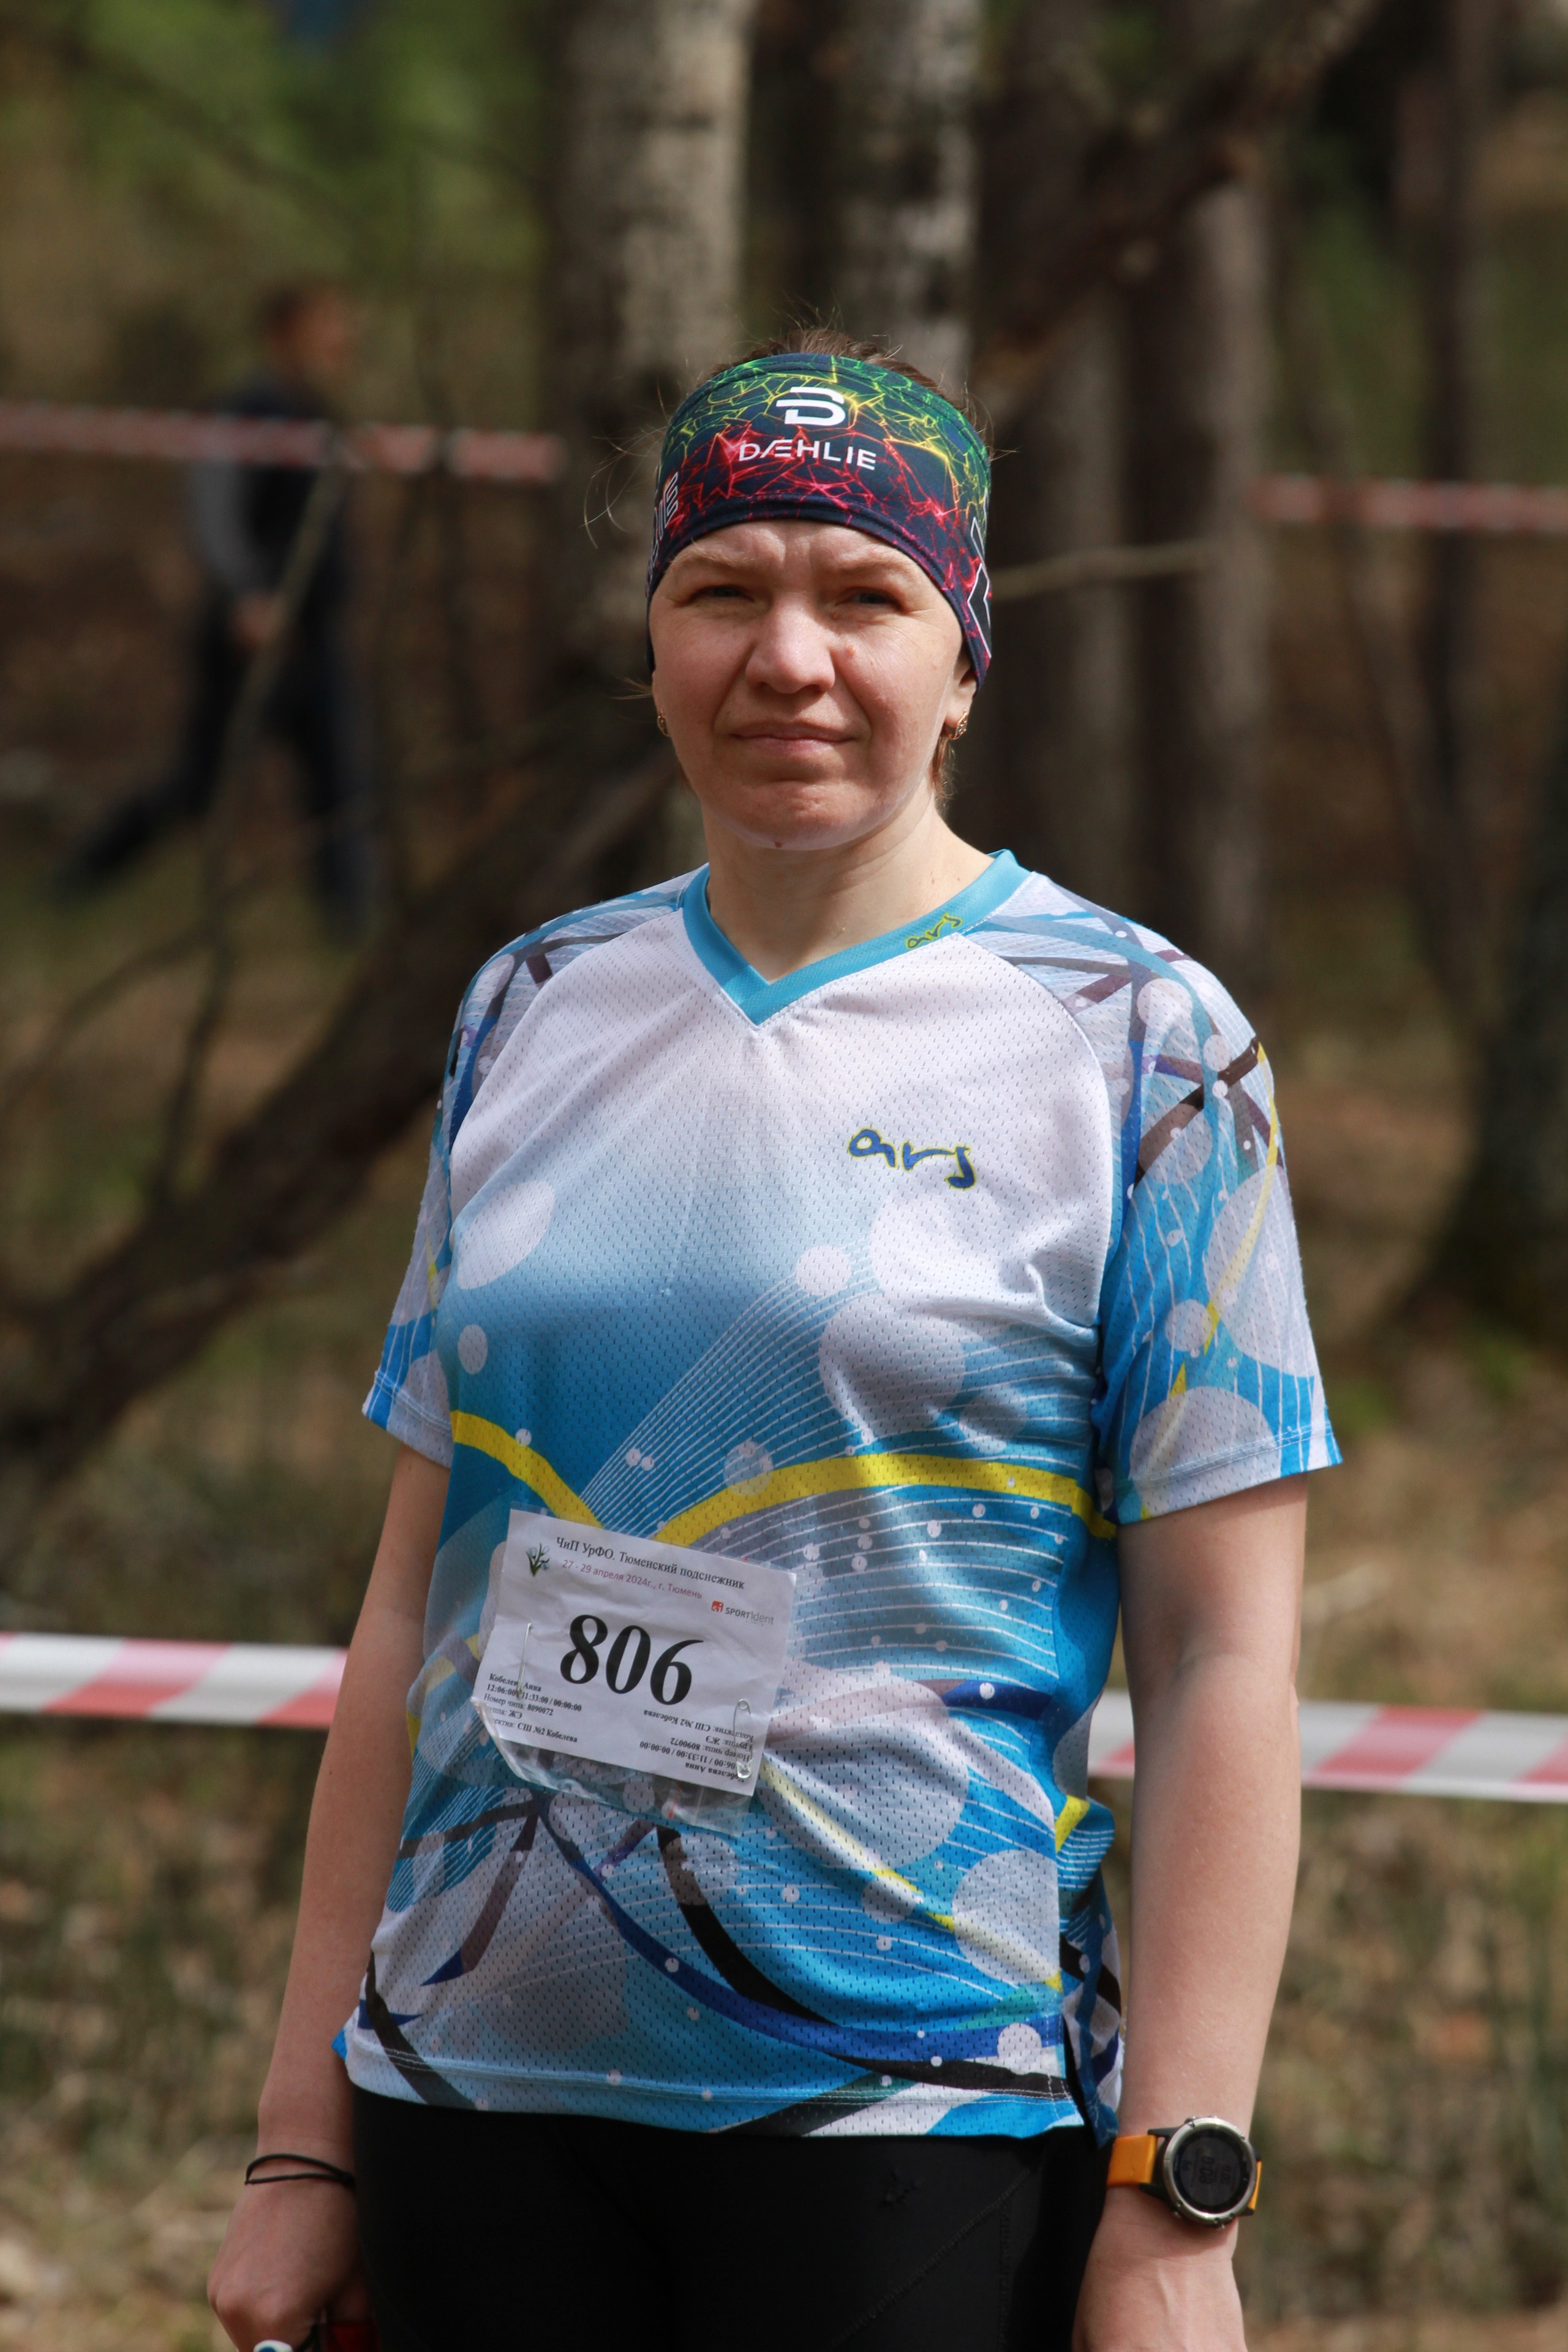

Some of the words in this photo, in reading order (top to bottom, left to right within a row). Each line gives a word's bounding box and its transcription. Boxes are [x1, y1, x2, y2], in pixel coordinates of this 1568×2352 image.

[739, 439, 877, 470] DÆHLIE
[556, 1537, 579, 1551] ЧиП
[582, 1543, 615, 1560] УрФО.
[619, 1551, 677, 1574] Тюменский
[680, 1569, 745, 1589] подснежник
[562, 1559, 574, 1569] 27
[580, 1564, 591, 1574] 29
[593, 1568, 624, 1581] апреля
[668, 1583, 702, 1599] Тюмень
[560, 1615, 704, 1705] 806
[489, 1673, 520, 1686] Кобелев
[523, 1683, 541, 1692] Анна
[484, 1694, 506, 1706] Номер
[507, 1700, 525, 1709] чипа:
[527, 1703, 554, 1716] 8090072
[487, 1684, 516, 1695] 12:06:00
[521, 1692, 548, 1704] 11:33:00
[554, 1700, 582, 1712] 00:00:00
[508, 1710, 522, 1719] ЖЭ
[644, 1709, 678, 1725] Кобелева
[680, 1719, 694, 1728] №2
[695, 1722, 710, 1732] СШ
[493, 1719, 515, 1728] ектив:
[517, 1722, 532, 1732] СШ
[533, 1726, 545, 1735] №2
[546, 1729, 578, 1743] Кобелева
[639, 1741, 670, 1754] 00:00:00
[671, 1737, 701, 1751] 8090072
[706, 1735, 721, 1746] ЖЭ
[676, 1749, 707, 1763] 11:33:00
[703, 1746, 723, 1754] чипа:
[685, 1762, 706, 1773] Анна
[714, 1759, 737, 1770] 06:00
[708, 1768, 745, 1782] обелева
